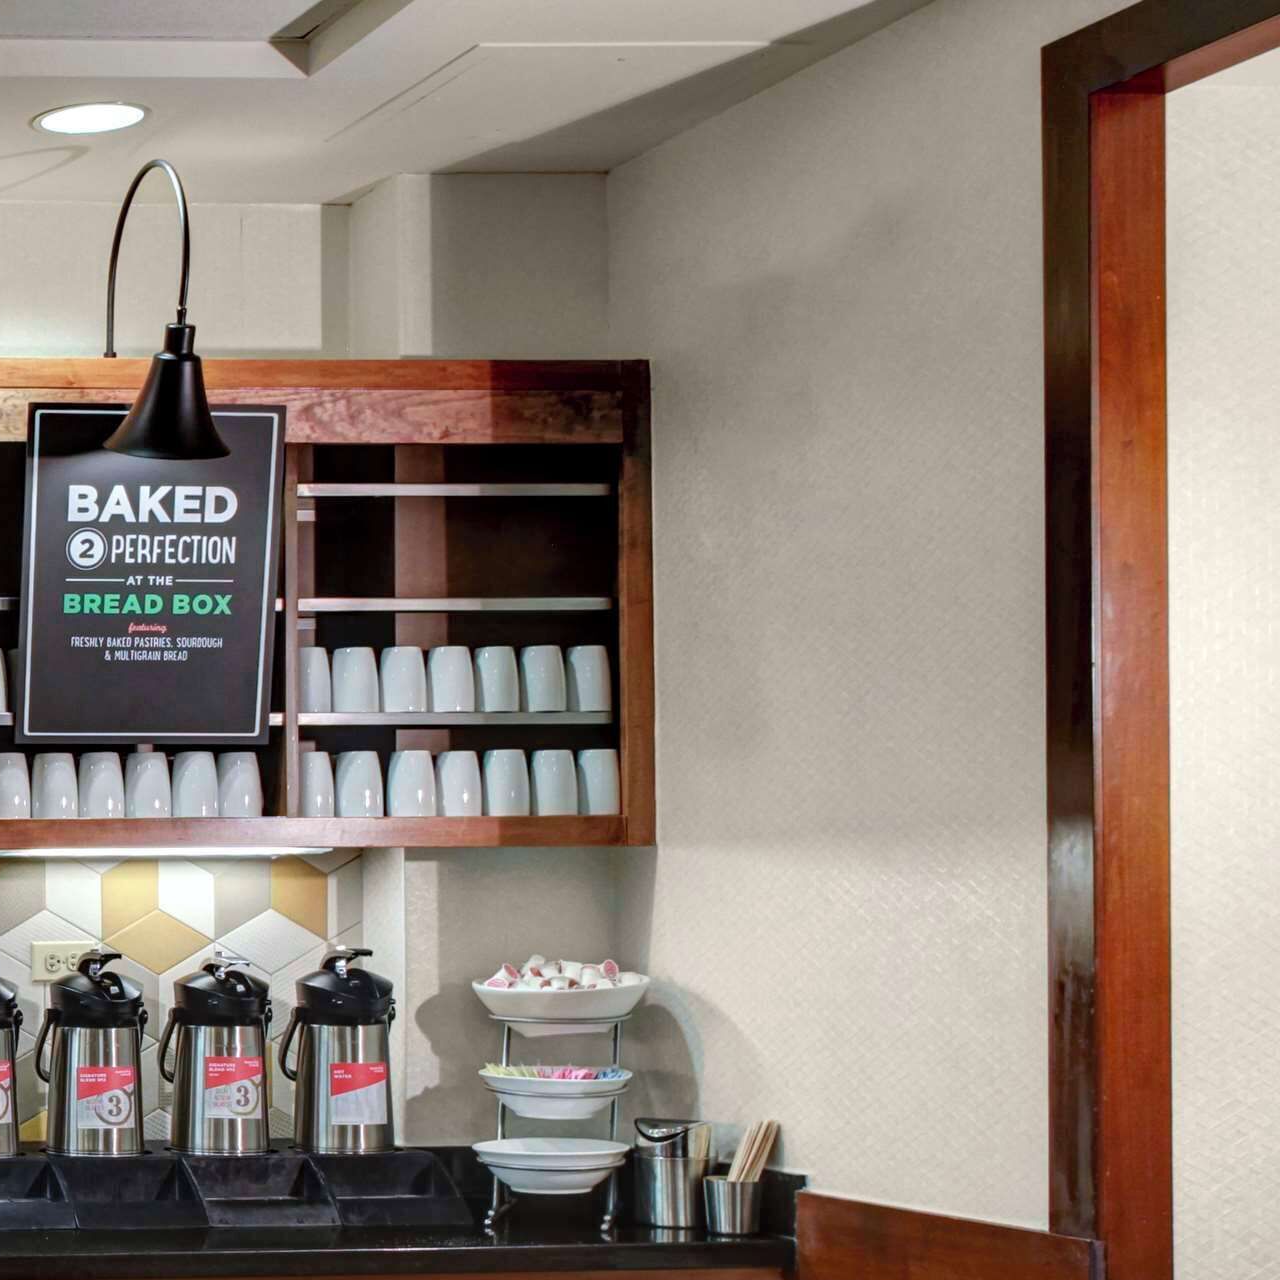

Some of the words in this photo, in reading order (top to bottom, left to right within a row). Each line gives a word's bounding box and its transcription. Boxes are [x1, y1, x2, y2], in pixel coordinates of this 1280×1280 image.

[67, 484, 238, 523] BAKED
[78, 537, 96, 560] 2
[110, 534, 237, 564] PERFECTION
[126, 575, 142, 586] AT
[147, 575, 174, 586] THE
[63, 593, 163, 615] BREAD
[172, 593, 233, 615] BOX
[127, 622, 168, 634] featuring
[70, 636, 104, 648] FRESHLY
[106, 636, 132, 648] BAKED
[176, 636, 223, 648] SOURDOUGH
[104, 650, 112, 661] &
[114, 650, 161, 661] MULTIGRAIN
[163, 650, 188, 661] BREAD
[108, 1095, 122, 1117] 3
[236, 1085, 250, 1107] 3
